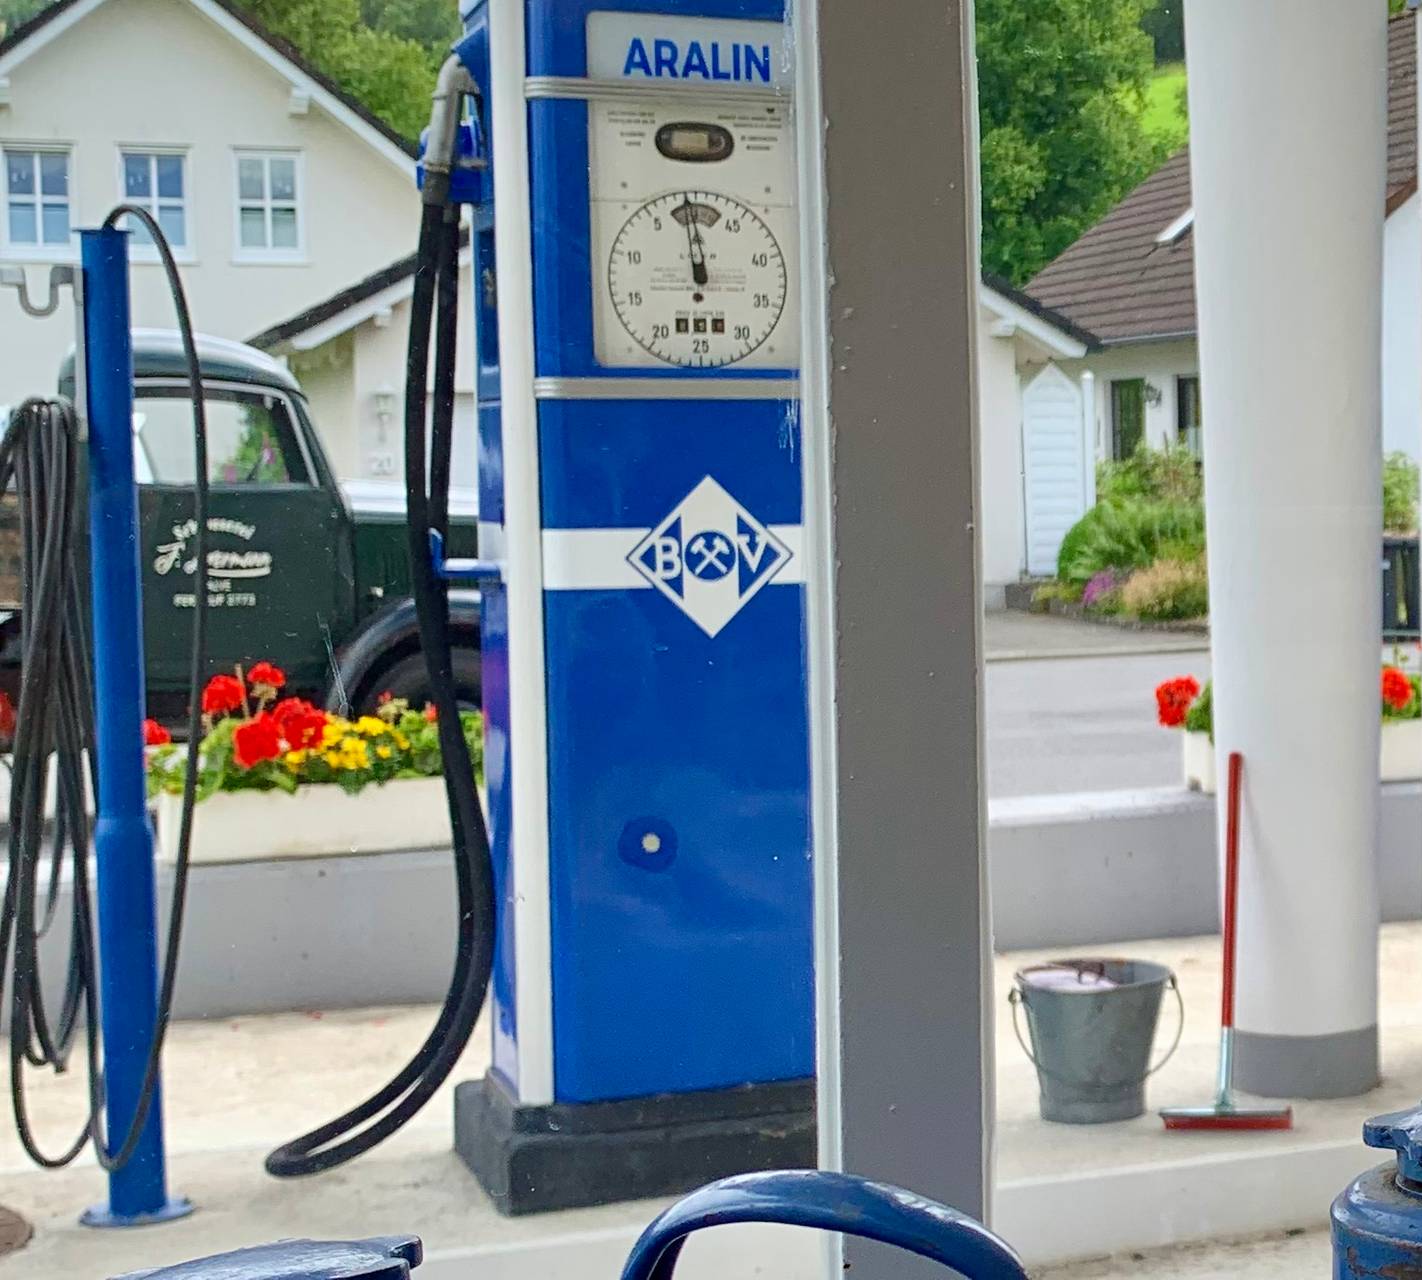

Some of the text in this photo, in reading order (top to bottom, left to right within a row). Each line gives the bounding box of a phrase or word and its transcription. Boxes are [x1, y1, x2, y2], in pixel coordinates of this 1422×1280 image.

[623, 37, 770, 83] ARALIN
[653, 217, 662, 231] 5
[724, 218, 741, 233] 45
[627, 250, 642, 265] 10
[751, 253, 768, 267] 40
[628, 292, 643, 306] 15
[753, 294, 770, 309] 35
[652, 325, 670, 340] 20
[734, 326, 750, 341] 30
[692, 340, 710, 354] 25
